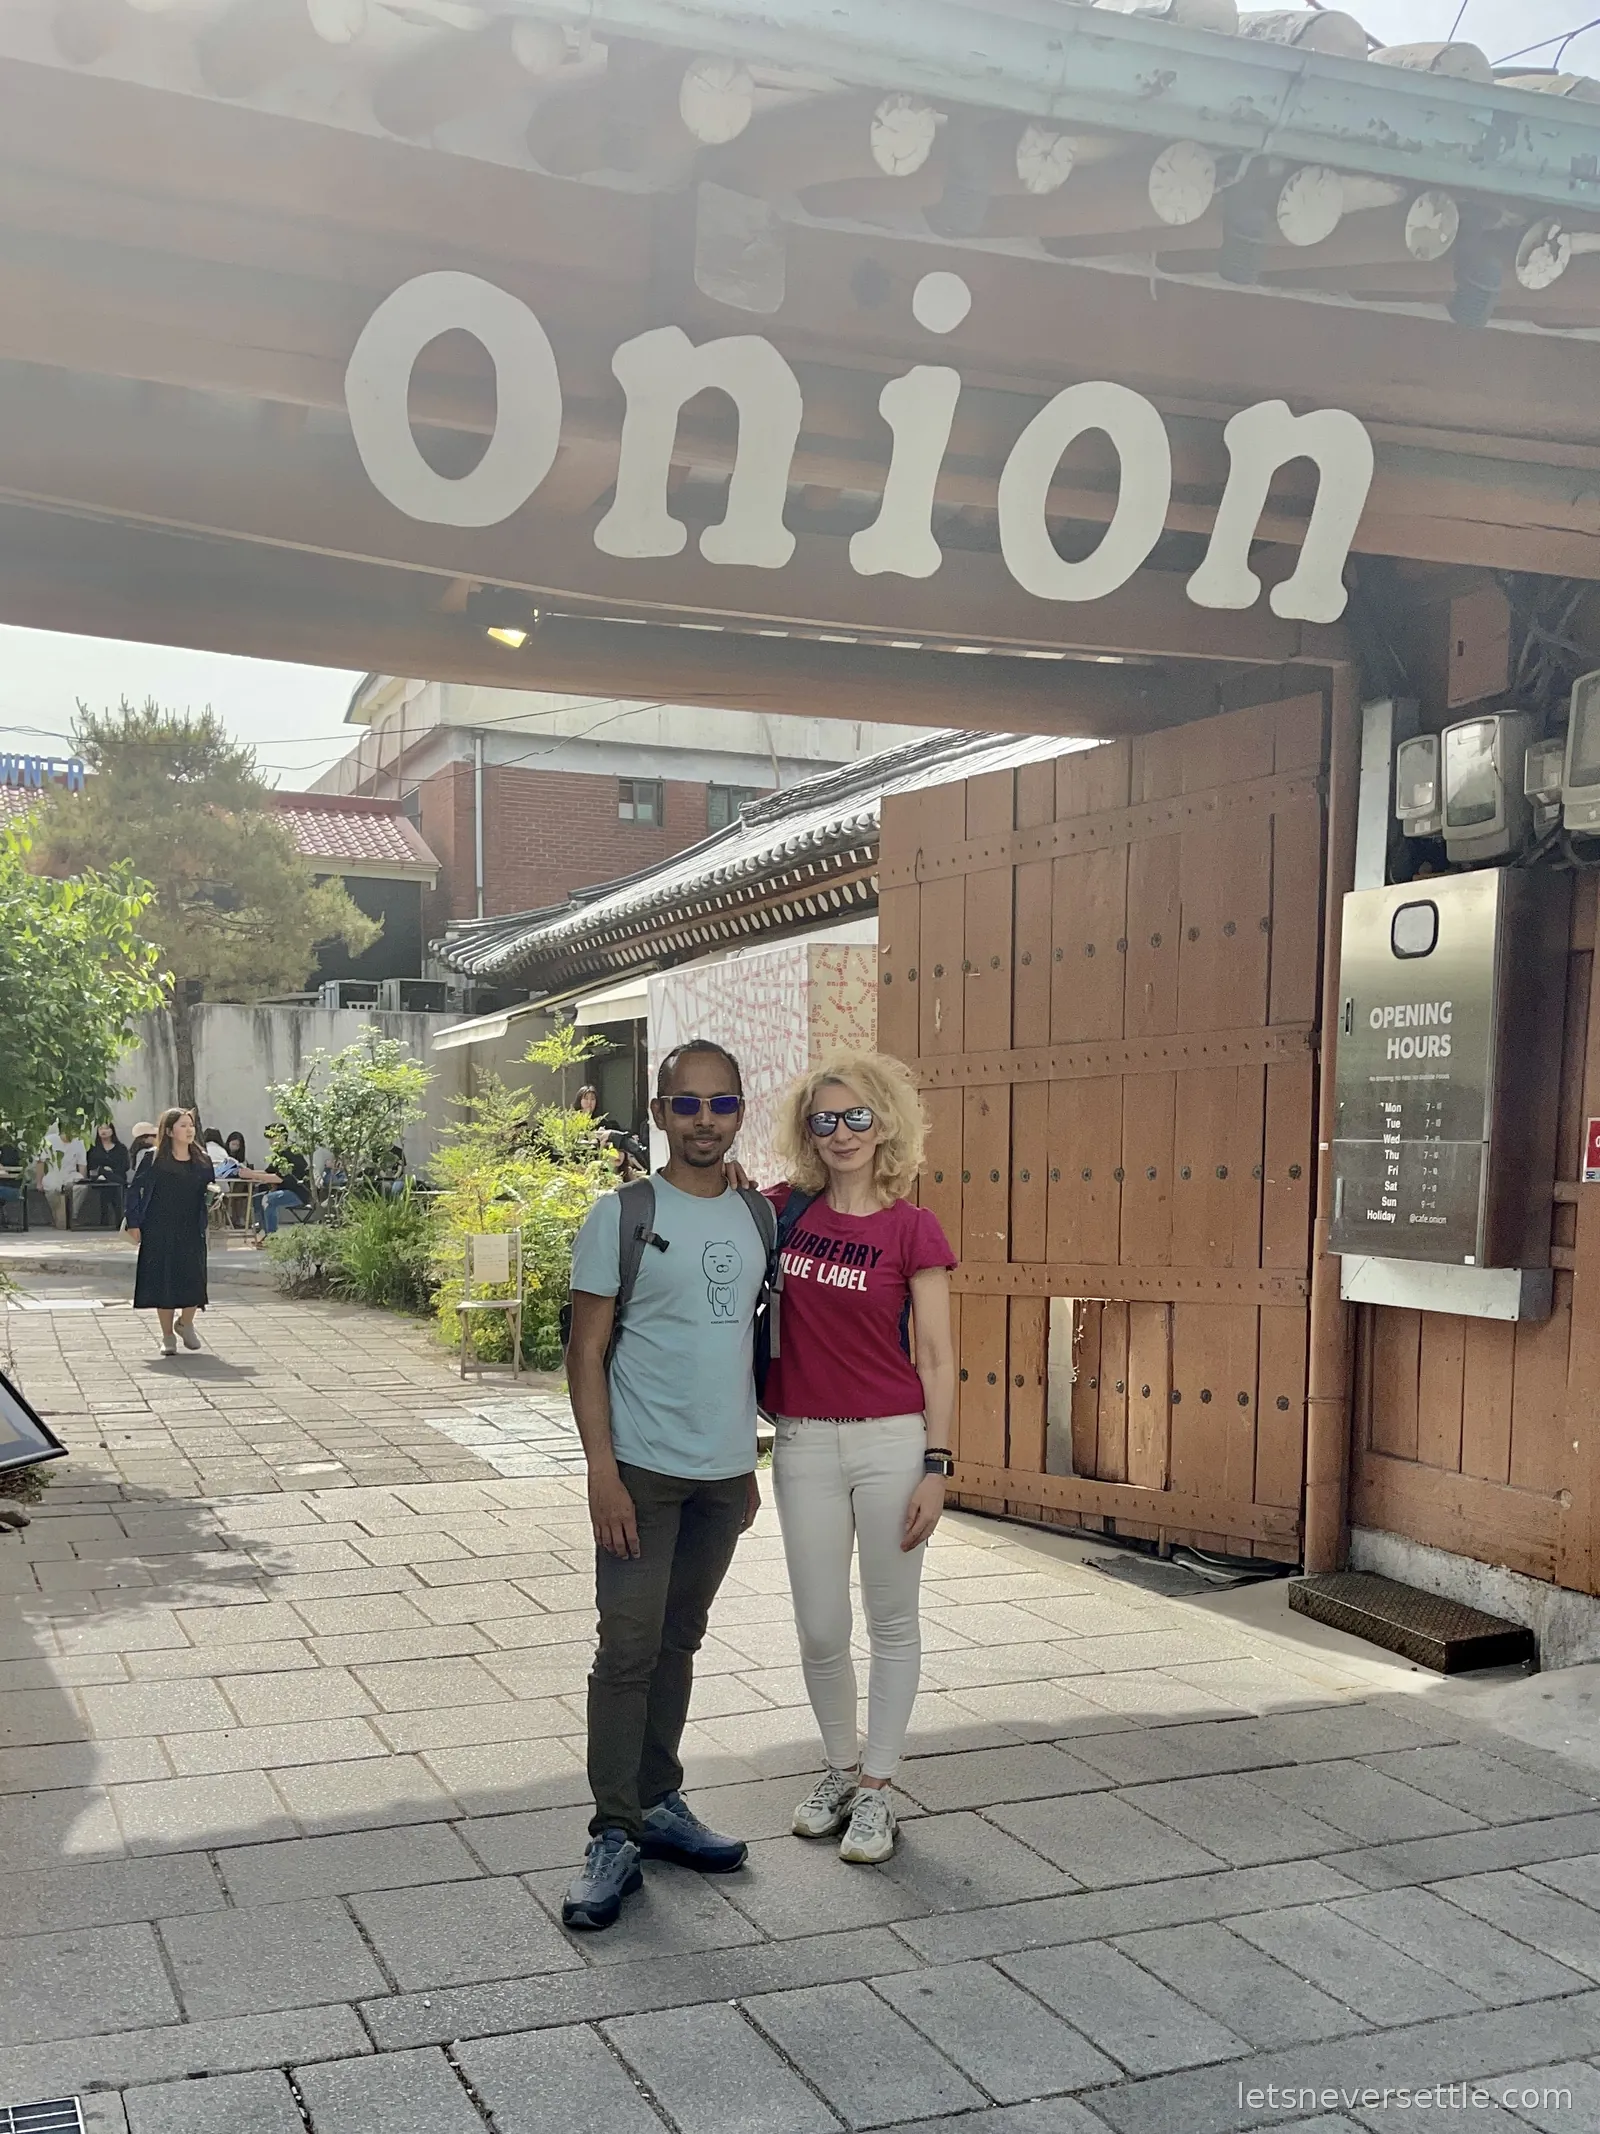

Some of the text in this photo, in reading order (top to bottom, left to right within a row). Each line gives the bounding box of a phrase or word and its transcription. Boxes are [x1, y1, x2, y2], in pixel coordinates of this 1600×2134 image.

[1369, 1001, 1453, 1029] OPENING
[1386, 1034, 1452, 1060] HOURS
[1384, 1102, 1402, 1113] Mon
[1385, 1118, 1401, 1129] Tue
[1383, 1134, 1401, 1144] Wed
[1384, 1149, 1400, 1160] Thu
[1387, 1165, 1399, 1176] Fri
[1384, 1180, 1398, 1191] Sat
[1381, 1196, 1397, 1207] Sun
[1366, 1209, 1447, 1224] Holiday @cafe.onion
[816, 1262, 868, 1291] LABEL
